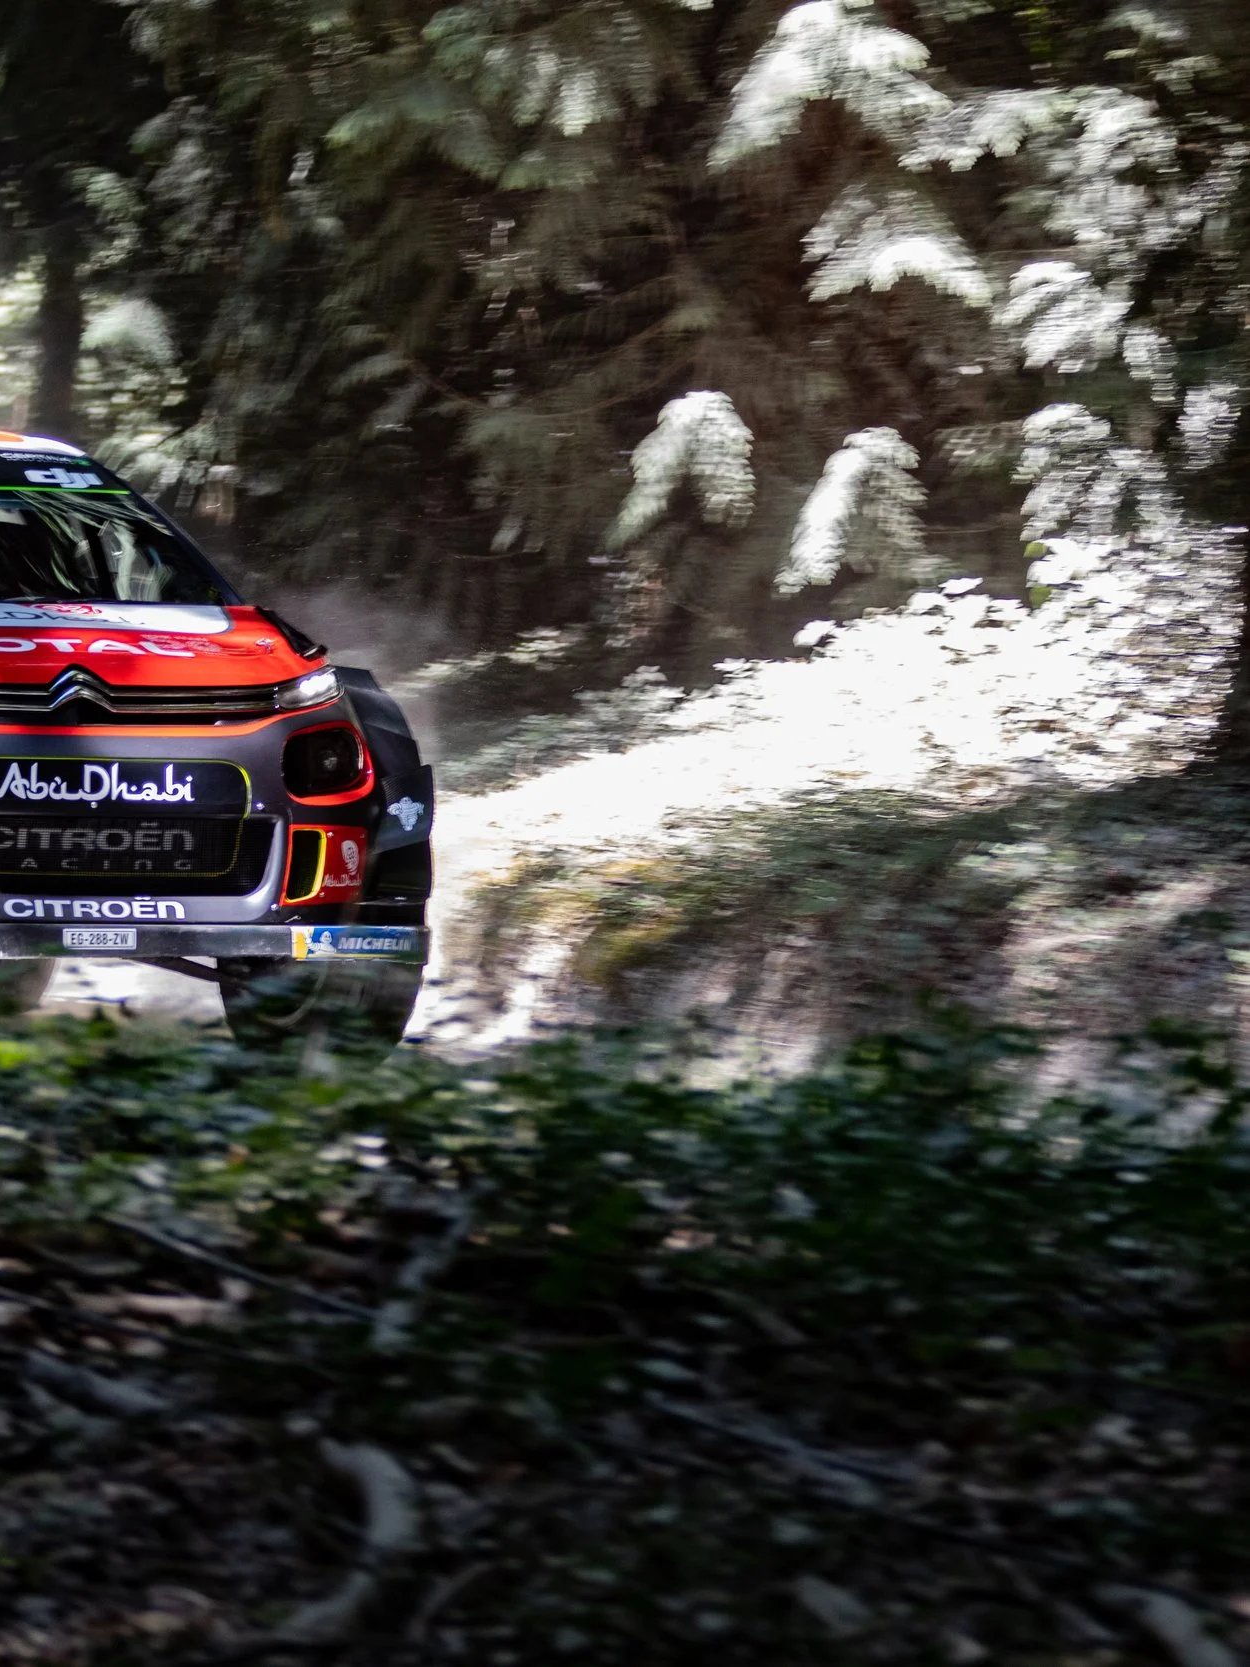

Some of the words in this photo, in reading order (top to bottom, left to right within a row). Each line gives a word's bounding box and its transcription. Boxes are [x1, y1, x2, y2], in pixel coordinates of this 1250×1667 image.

[3, 896, 186, 920] CITROËN
[70, 932, 131, 946] EG-288-ZW
[338, 936, 413, 951] MICHELIN
